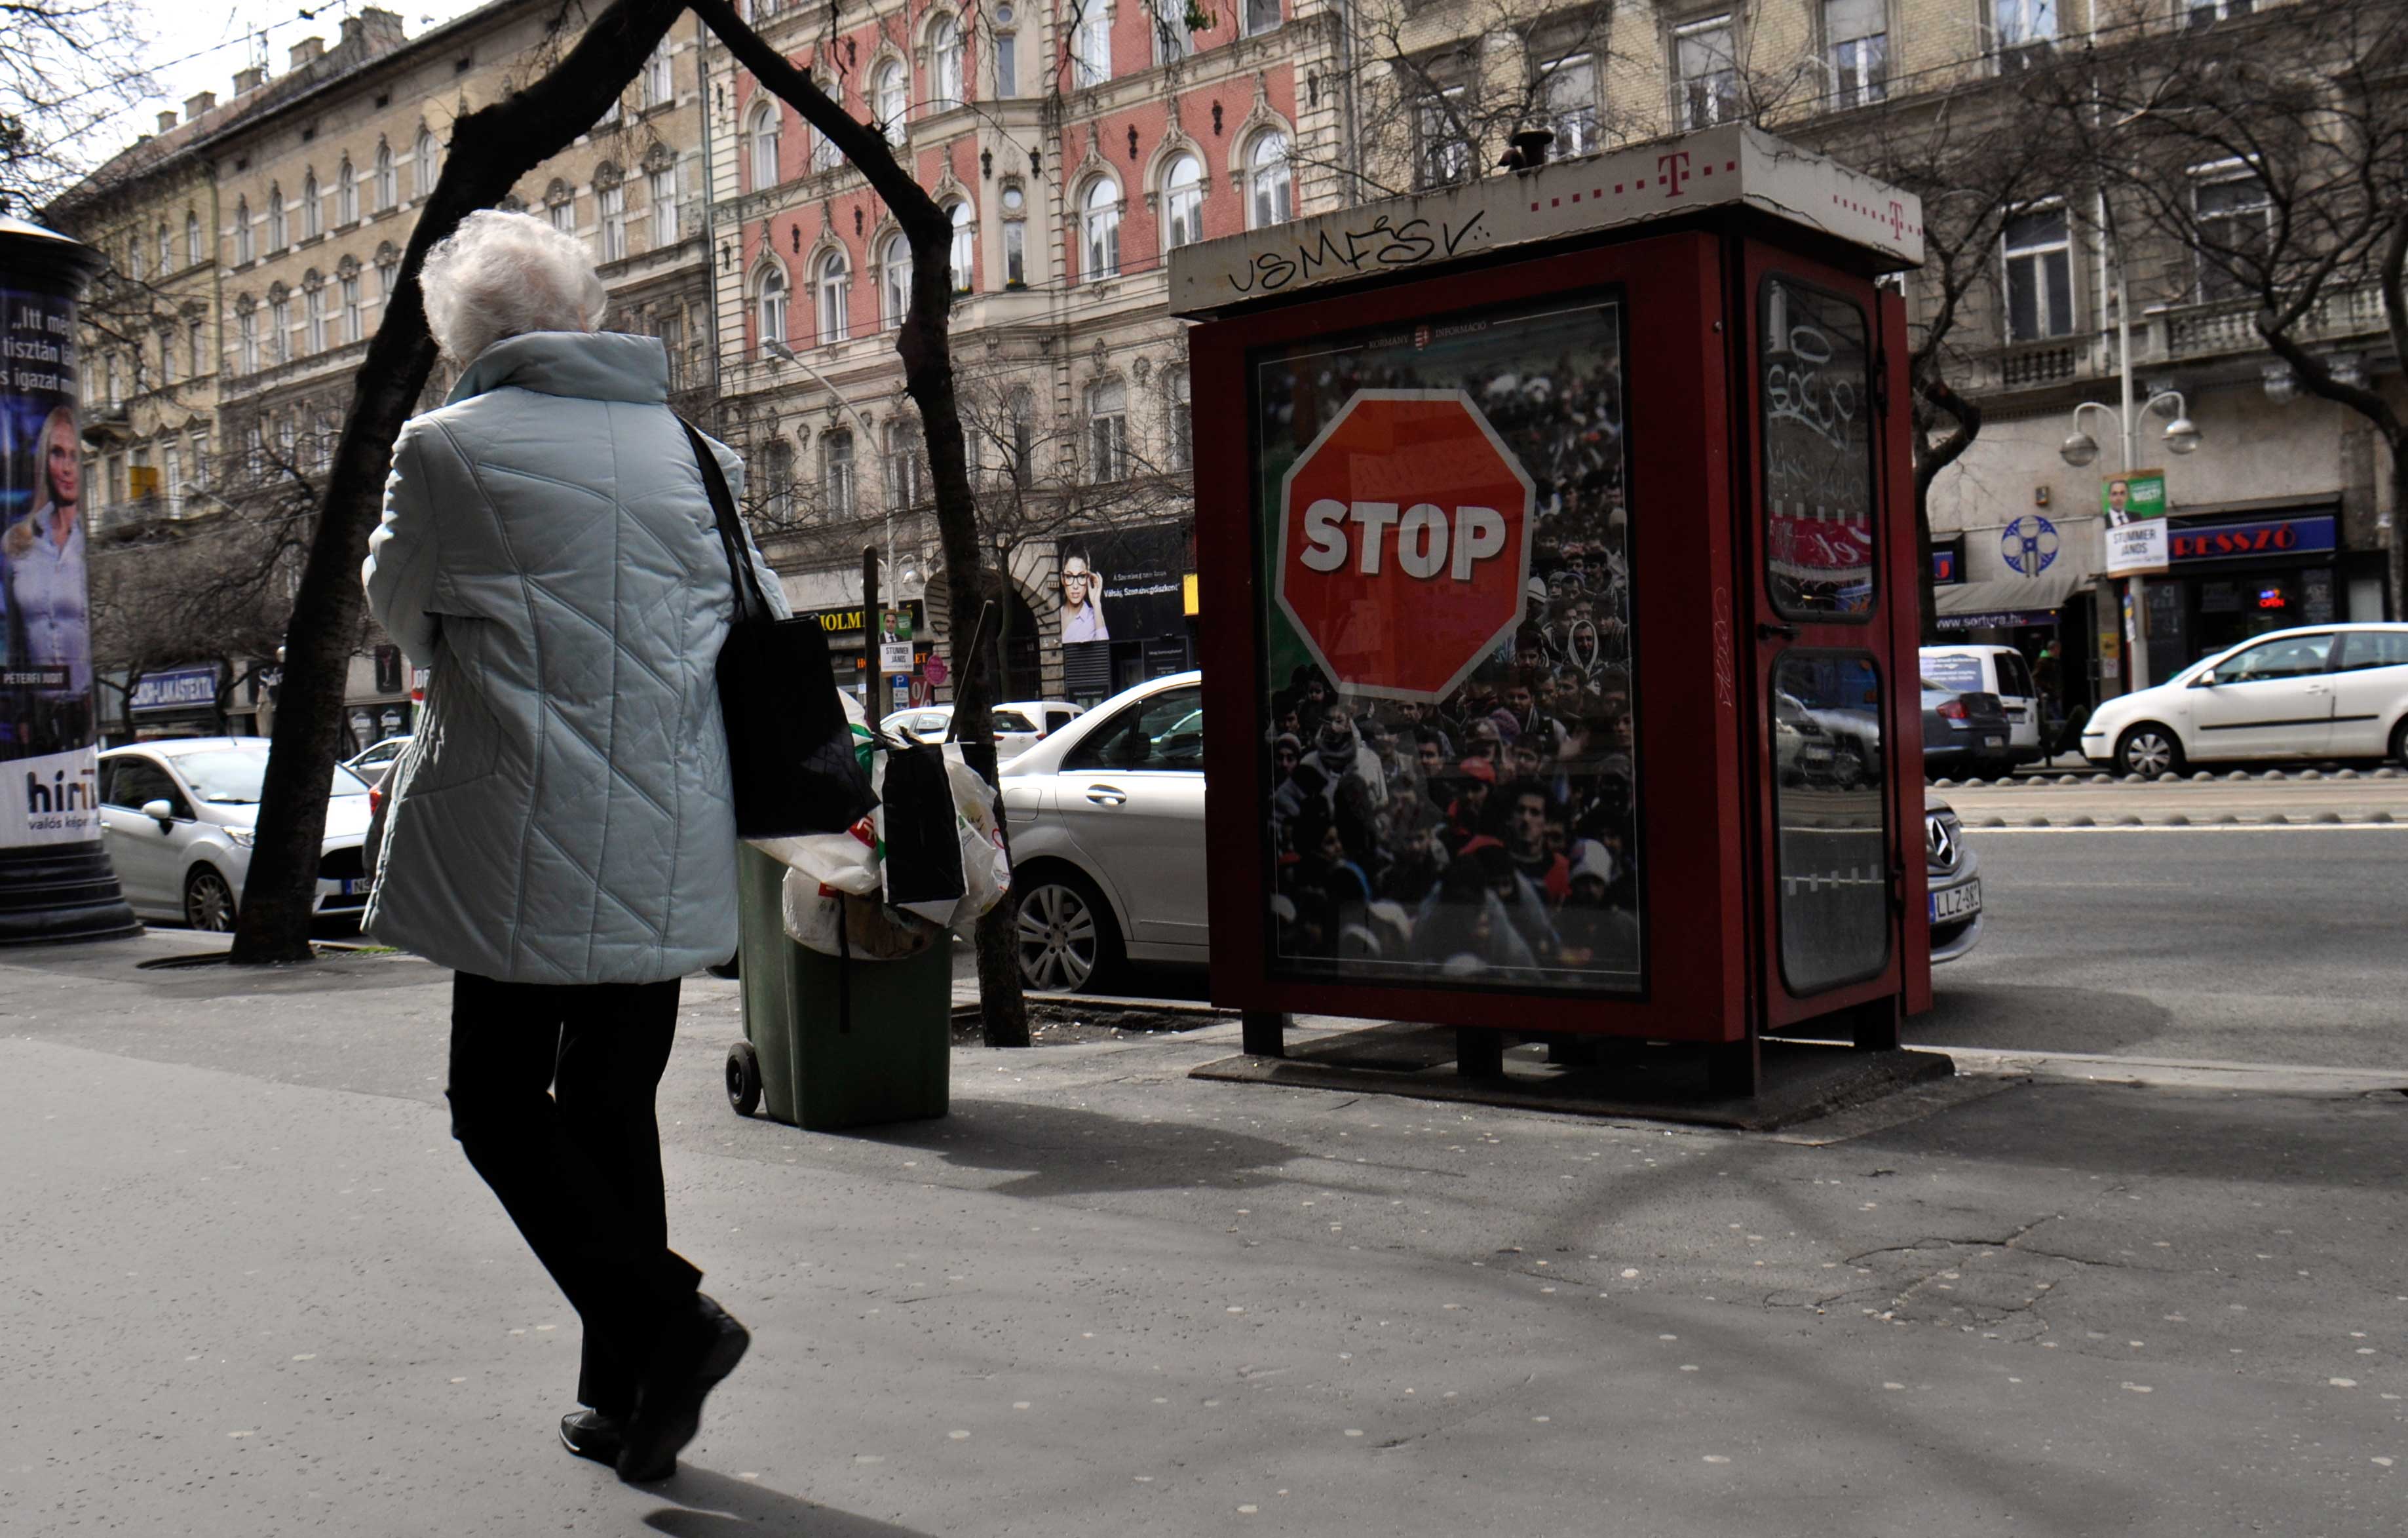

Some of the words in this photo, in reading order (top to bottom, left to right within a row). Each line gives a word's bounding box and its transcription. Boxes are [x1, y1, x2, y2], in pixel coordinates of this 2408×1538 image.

[1658, 152, 1690, 197] T
[1890, 201, 1902, 240] T
[3, 336, 58, 363] tisztán
[14, 368, 58, 392] igazat
[1300, 499, 1506, 581] STOP
[2168, 523, 2296, 556] RESSZÓ
[2259, 598, 2285, 607] OPEN
[896, 676, 904, 687] P
